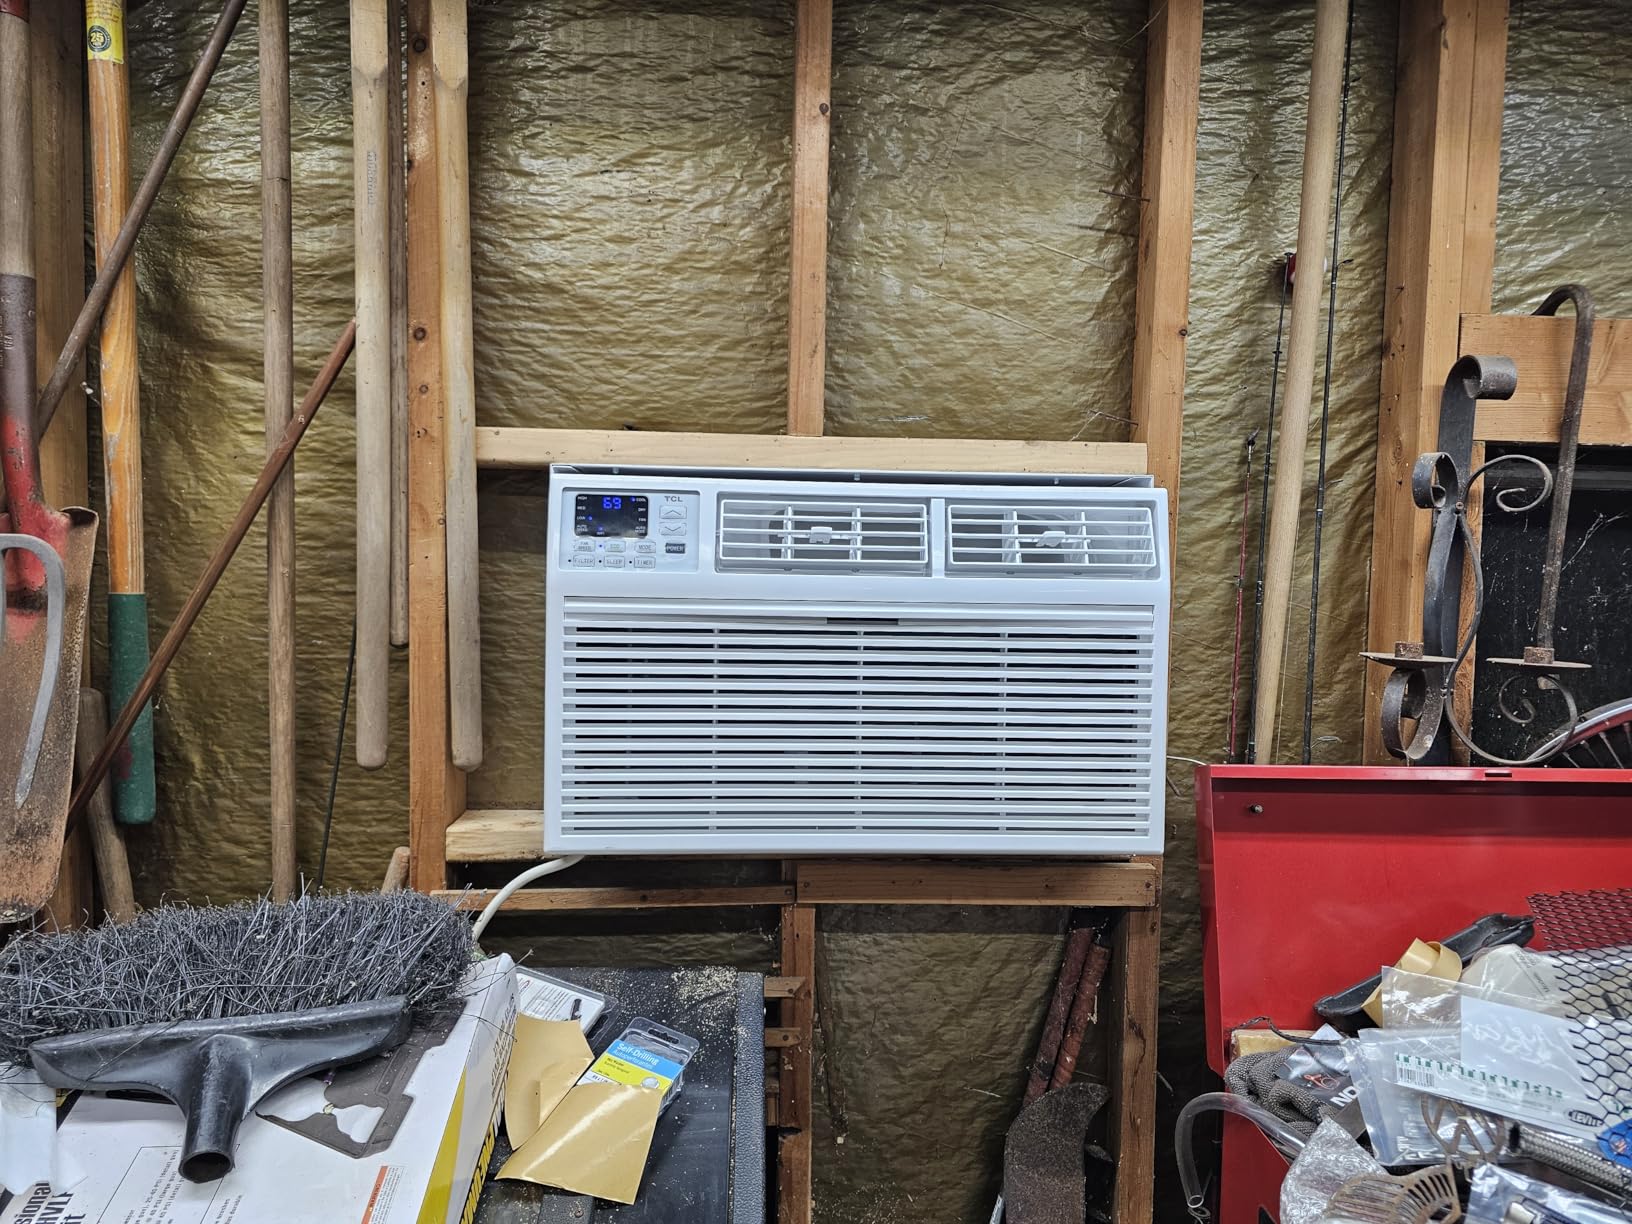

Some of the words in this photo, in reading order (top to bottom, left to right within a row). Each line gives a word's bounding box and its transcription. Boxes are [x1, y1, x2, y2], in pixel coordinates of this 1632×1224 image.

[90, 32, 104, 42] 25
[603, 496, 622, 510] 69
[616, 1042, 660, 1066] Self-Drilling
